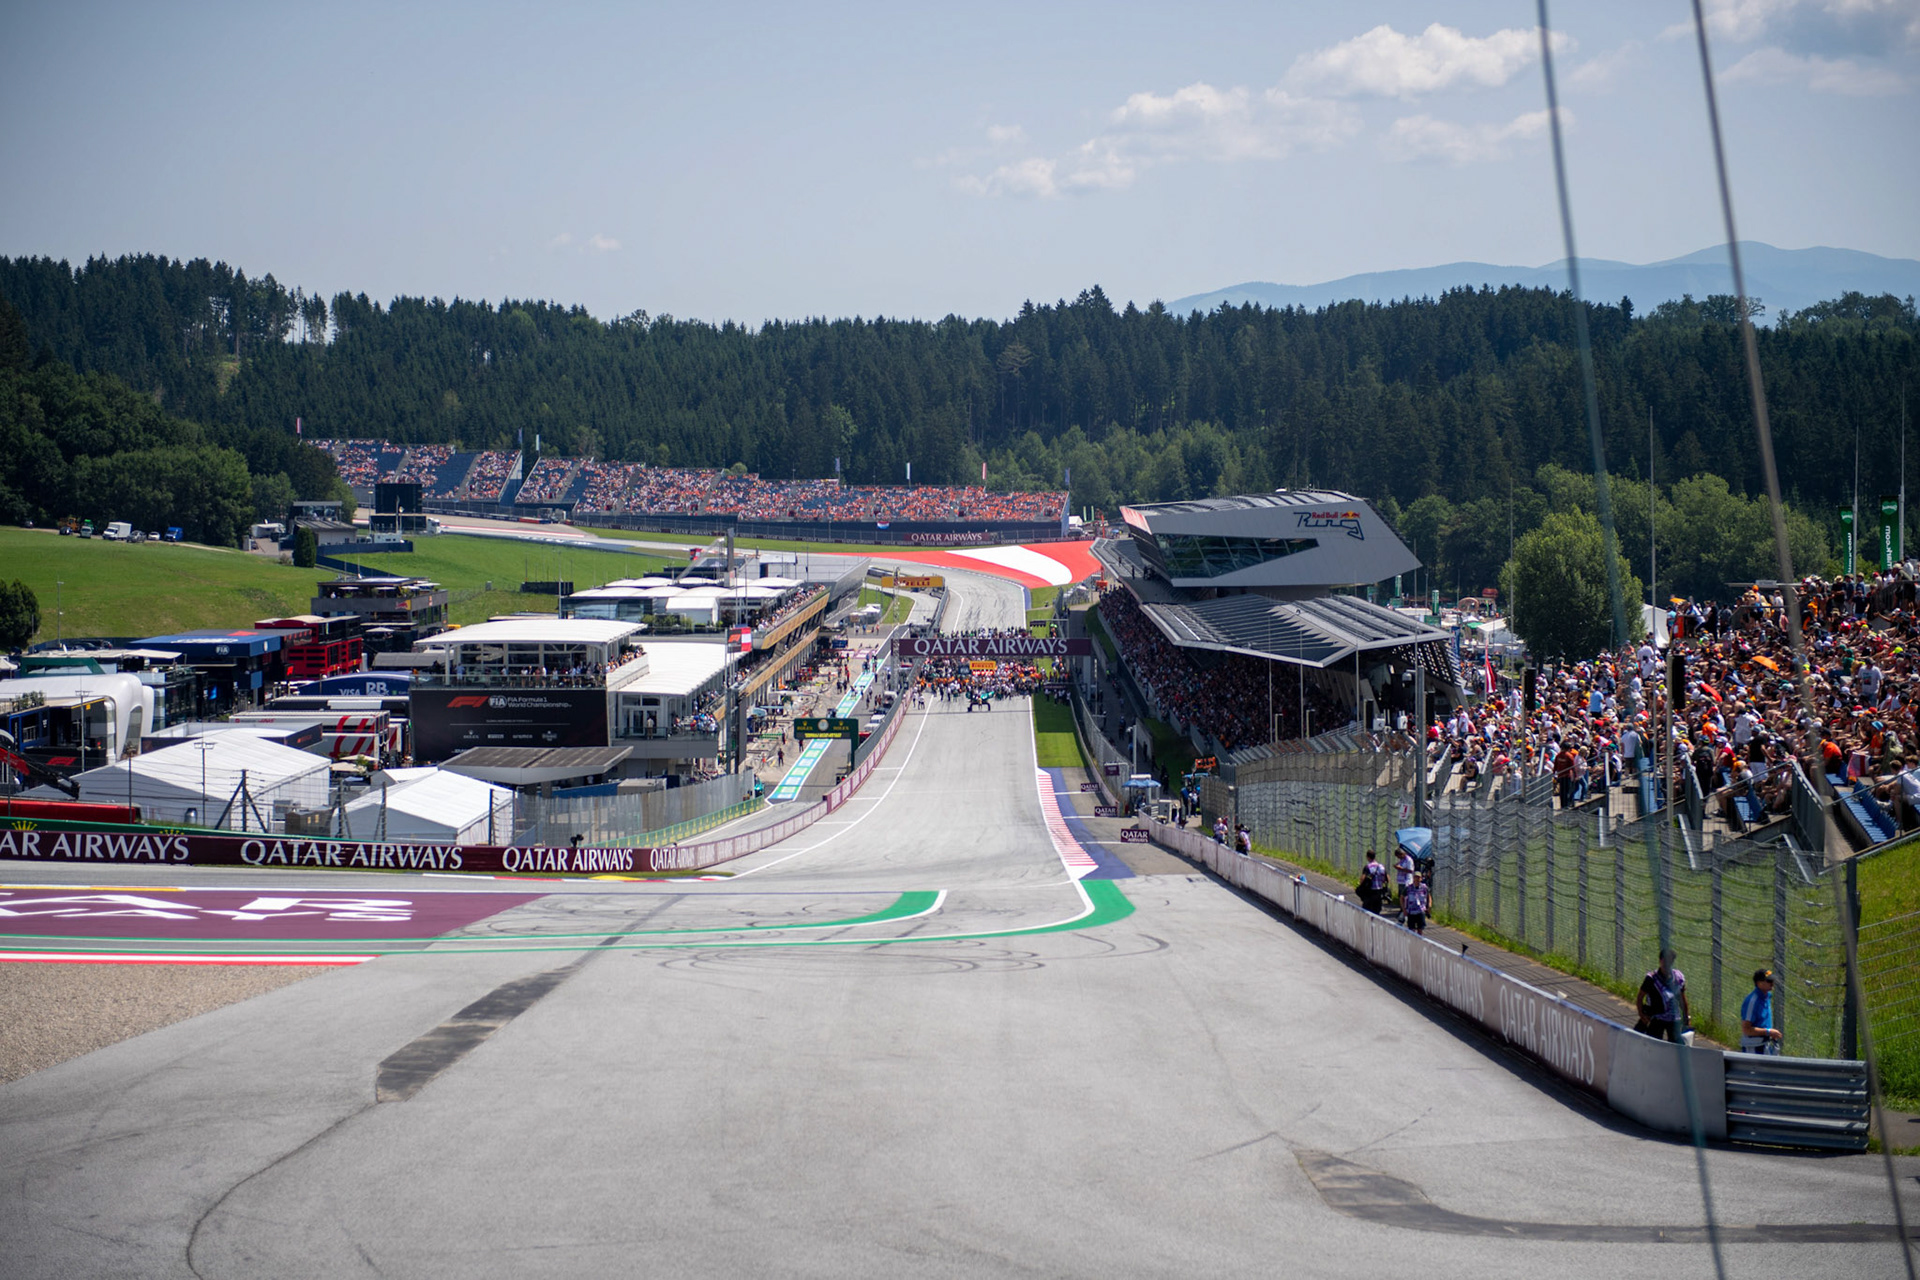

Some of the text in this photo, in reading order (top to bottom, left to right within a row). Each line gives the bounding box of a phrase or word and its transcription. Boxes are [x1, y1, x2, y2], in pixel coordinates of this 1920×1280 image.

[911, 533, 982, 542] QATAR AIRWAYS
[914, 639, 1068, 655] QATAR AIRWAYS
[489, 697, 506, 706] FIA
[50, 833, 189, 861] AIRWAYS
[1121, 831, 1148, 839] QATAR
[240, 840, 463, 870] QATAR AIRWAYS
[502, 847, 634, 872] QATAR AIRWAYS
[650, 848, 678, 872] QATAR
[1421, 946, 1485, 1022] QATAR AIRWAYS
[1499, 984, 1595, 1086] QATAR AIRWAYS
